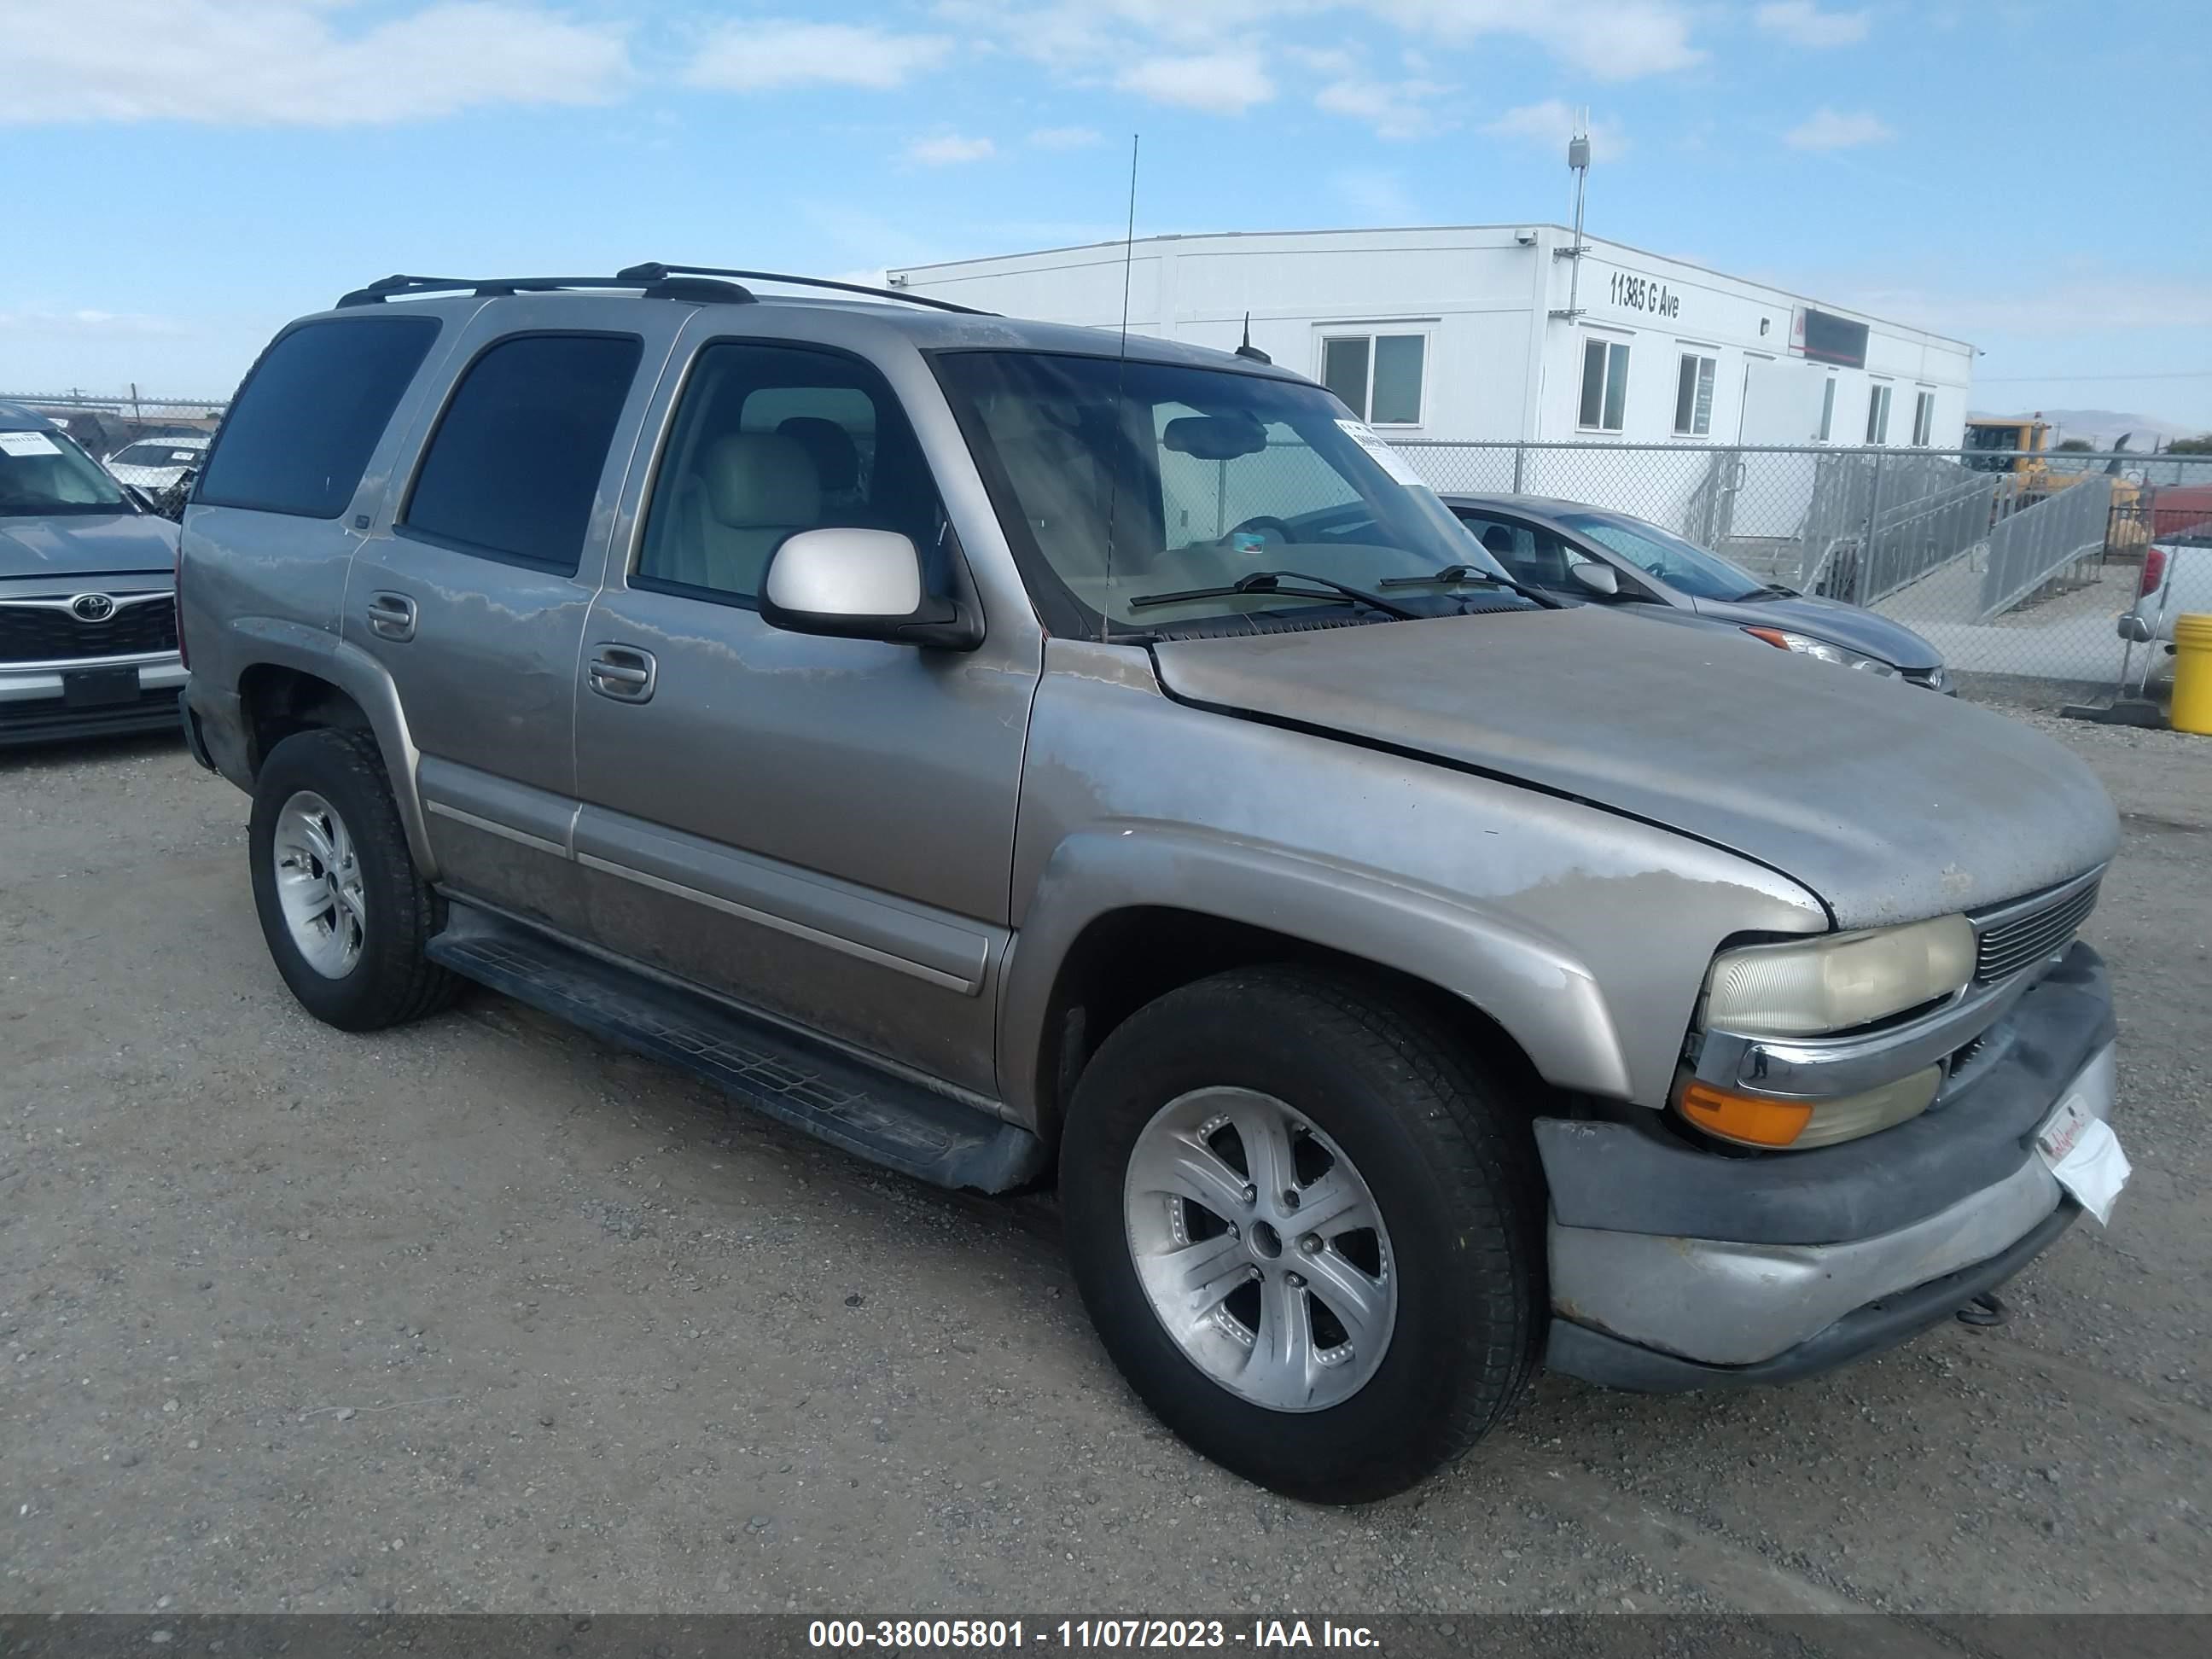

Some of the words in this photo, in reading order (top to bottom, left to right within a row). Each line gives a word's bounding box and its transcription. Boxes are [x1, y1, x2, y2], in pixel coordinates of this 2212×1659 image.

[1610, 271, 1646, 311] 11385
[1648, 282, 1657, 313] G
[1658, 285, 1679, 318] Ave
